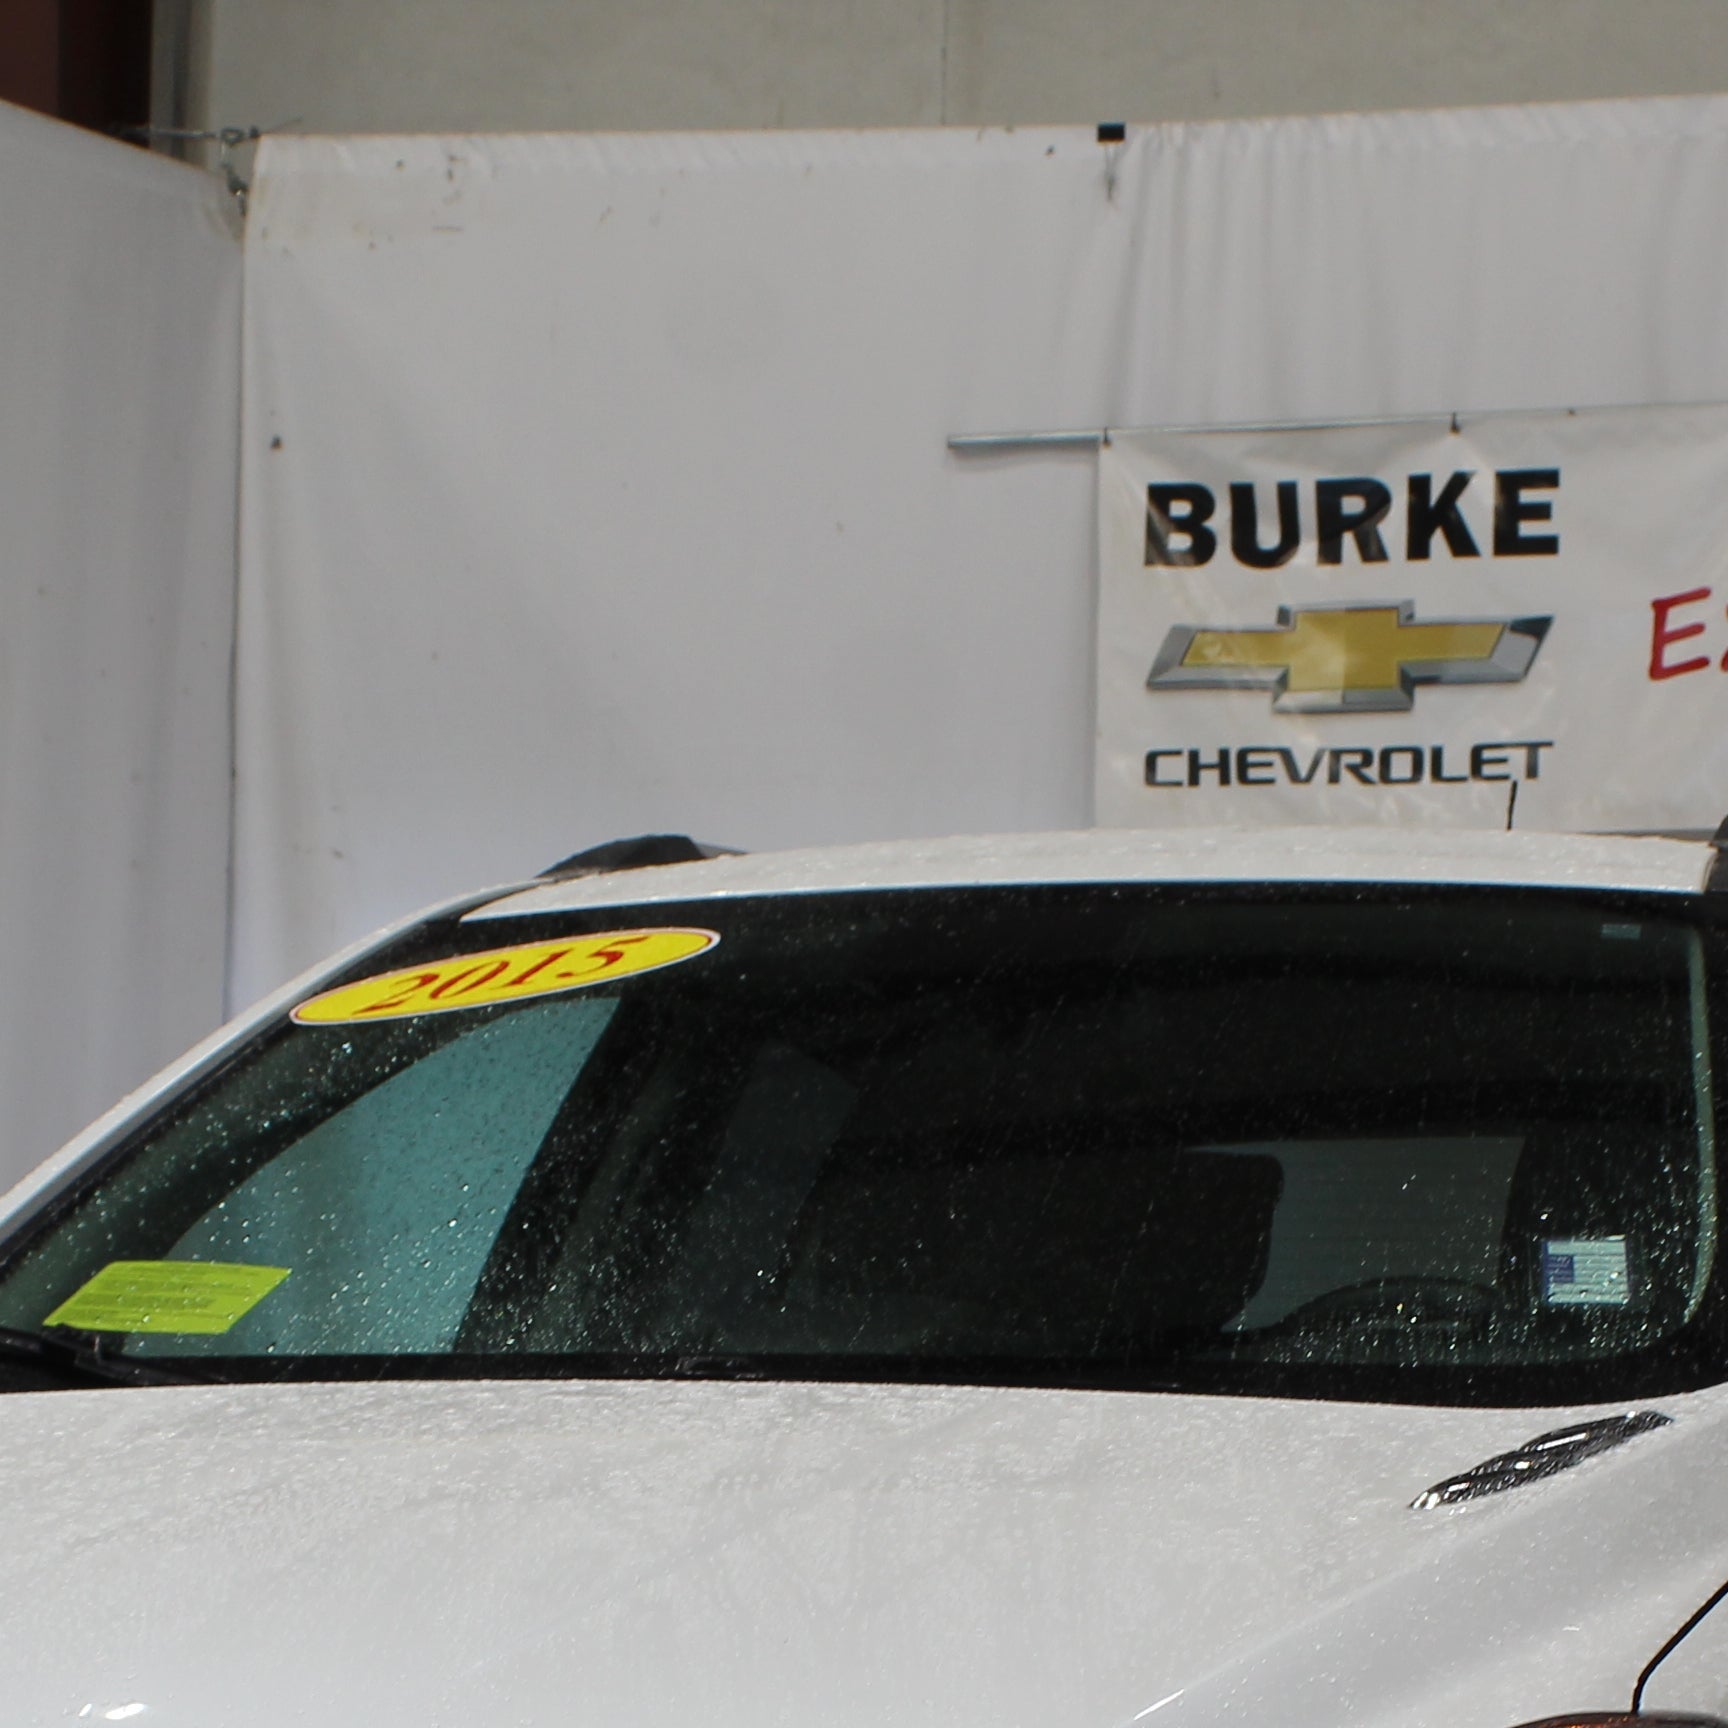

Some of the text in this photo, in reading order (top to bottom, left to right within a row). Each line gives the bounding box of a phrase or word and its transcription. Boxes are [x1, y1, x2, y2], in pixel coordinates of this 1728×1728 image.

[1144, 468, 1561, 570] BURKE
[1144, 740, 1555, 787] CHEVROLET
[351, 936, 650, 1015] 2015
